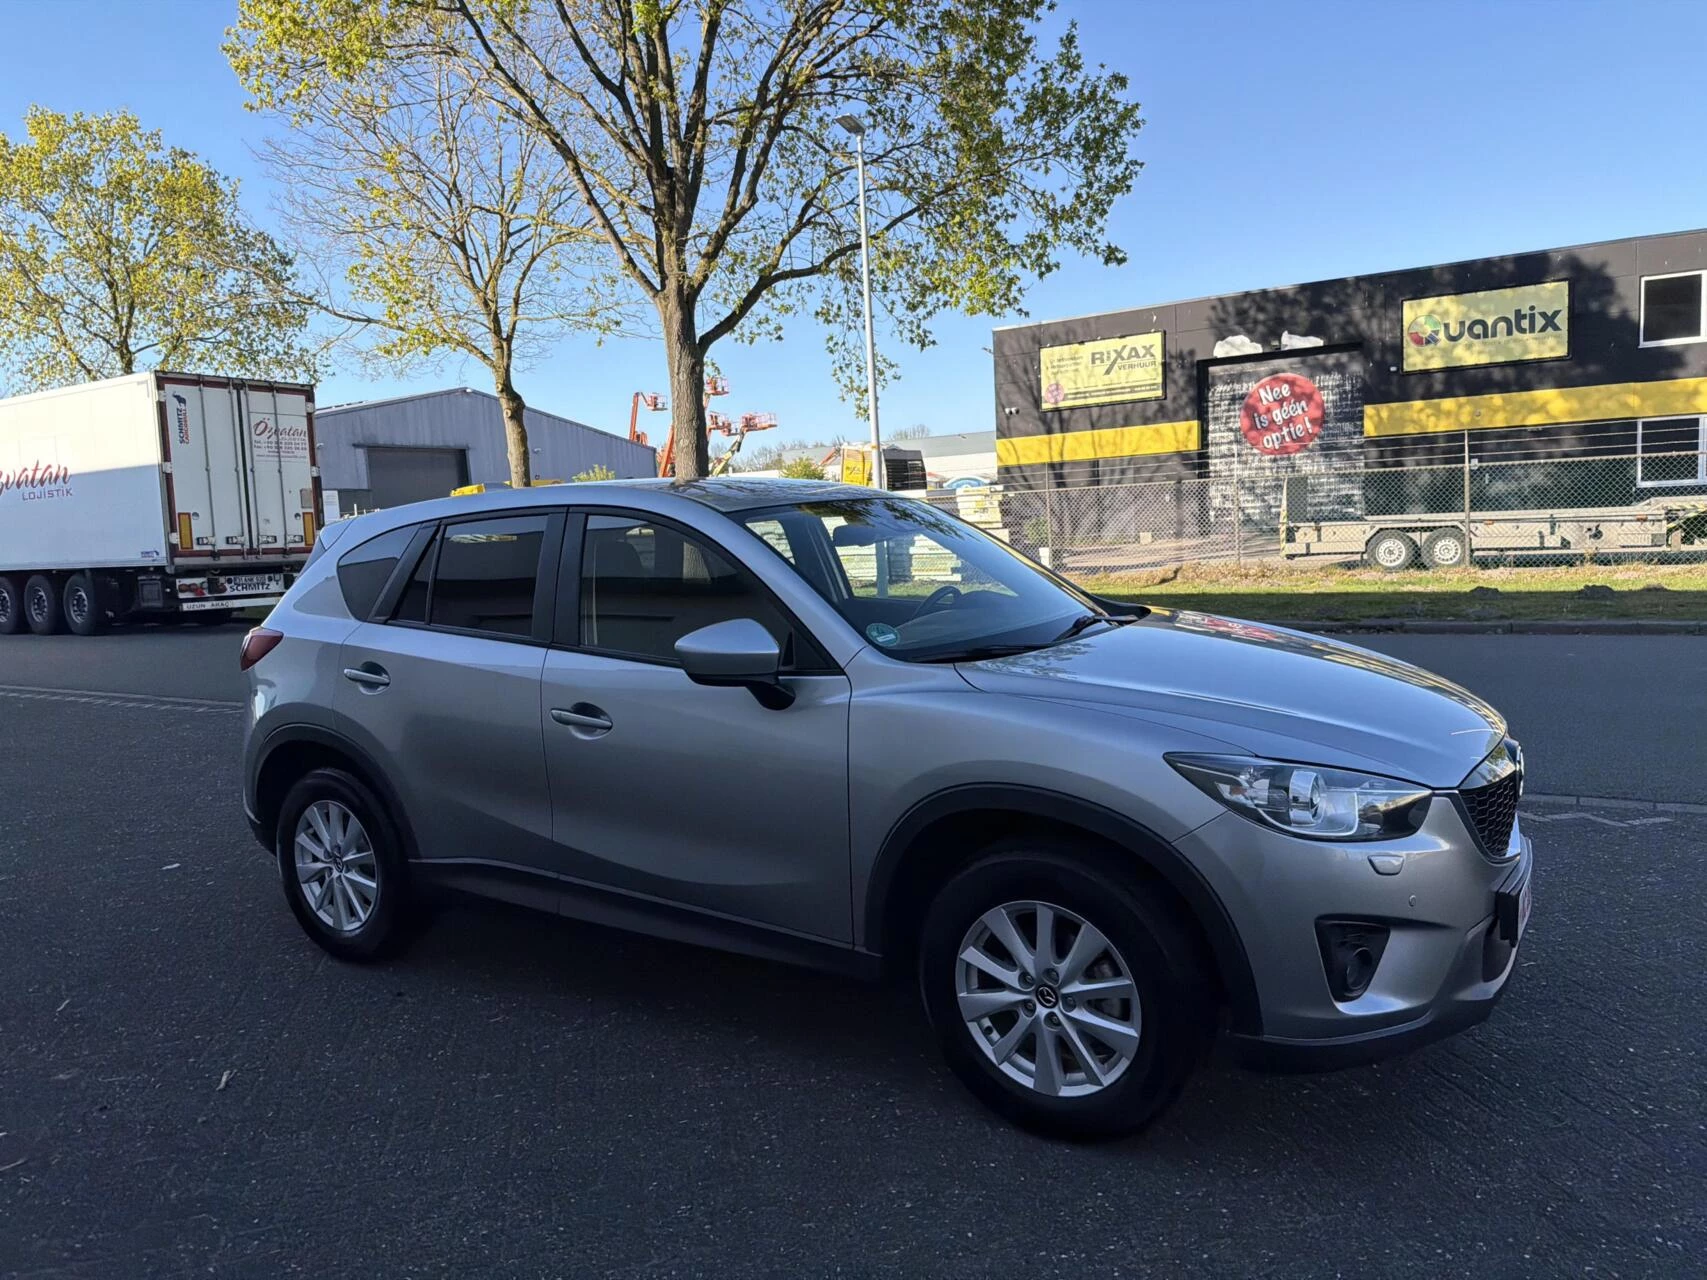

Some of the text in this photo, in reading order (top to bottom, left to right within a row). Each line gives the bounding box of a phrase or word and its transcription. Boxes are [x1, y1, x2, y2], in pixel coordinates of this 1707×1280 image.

[1408, 305, 1563, 348] Quantix
[1117, 361, 1157, 371] VERHUUR
[1258, 383, 1291, 405] Nee
[1253, 398, 1309, 430] is géén
[176, 407, 185, 444] SCHMITZ
[230, 583, 271, 593] SCHMITZ
[186, 602, 206, 610] UZUN
